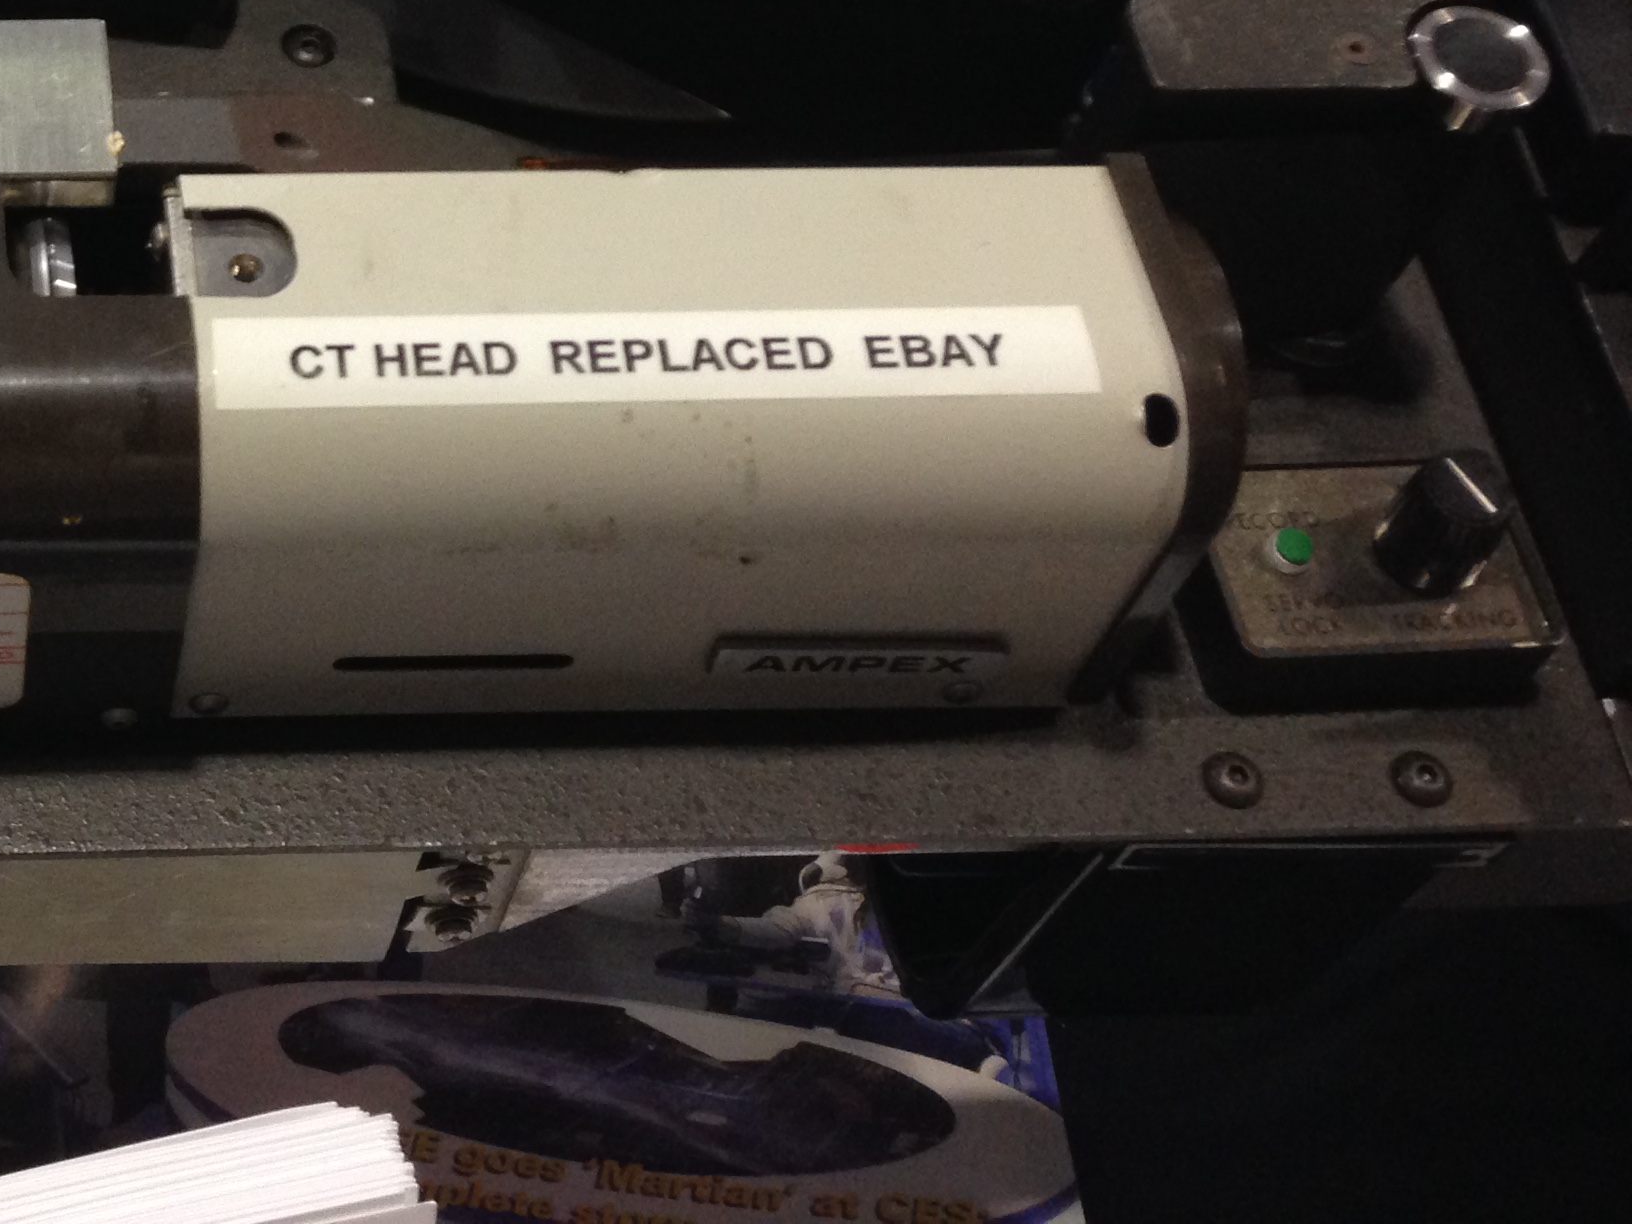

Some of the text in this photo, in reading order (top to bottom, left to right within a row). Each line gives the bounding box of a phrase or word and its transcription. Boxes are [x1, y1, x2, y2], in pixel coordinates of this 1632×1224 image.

[288, 333, 1003, 379] CT HEAD REPLACED EBAY
[744, 654, 972, 674] AMPEX
[452, 1141, 566, 1183] goes
[809, 1192, 858, 1221] at
